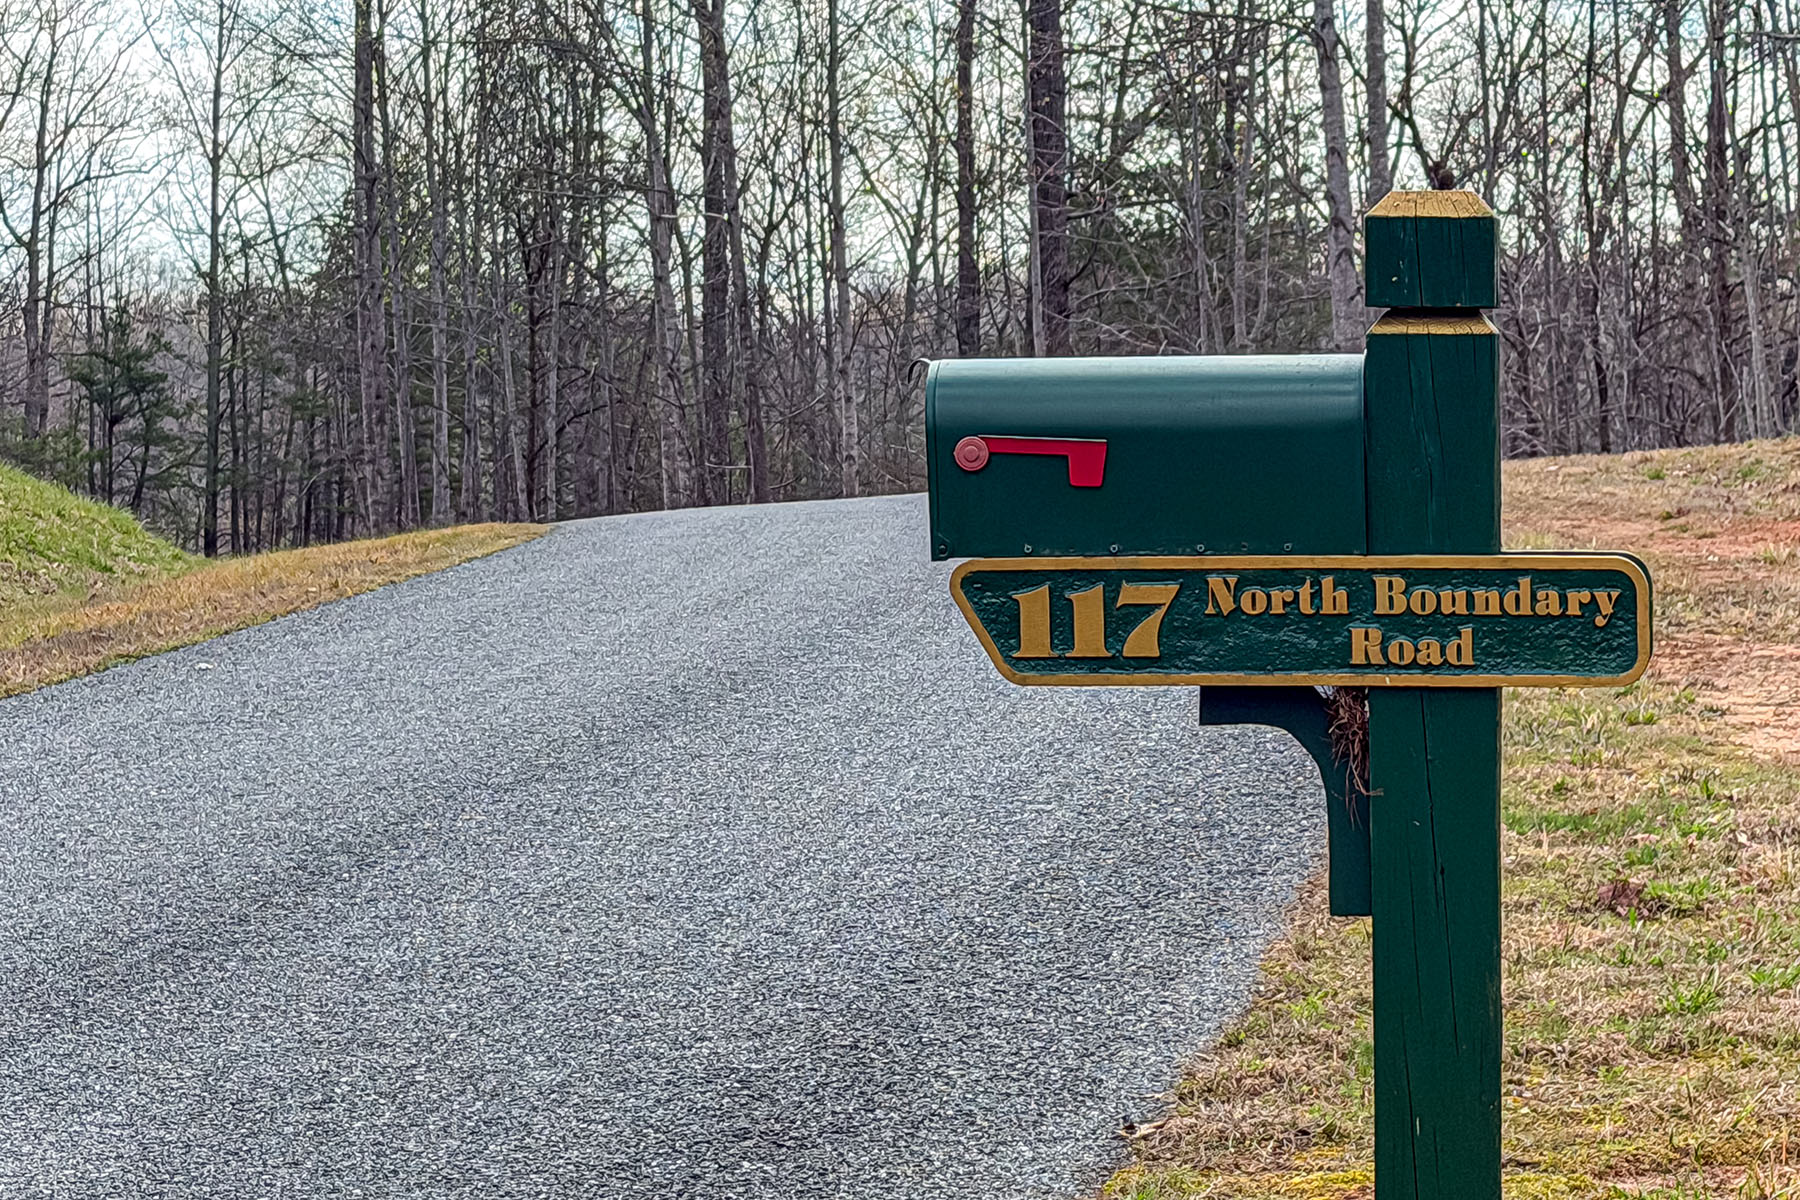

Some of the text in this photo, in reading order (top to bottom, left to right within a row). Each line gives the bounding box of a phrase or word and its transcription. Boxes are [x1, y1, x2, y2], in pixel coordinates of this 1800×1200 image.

[1011, 583, 1181, 659] 117
[1205, 576, 1621, 628] North Boundary
[1350, 627, 1474, 666] Road
